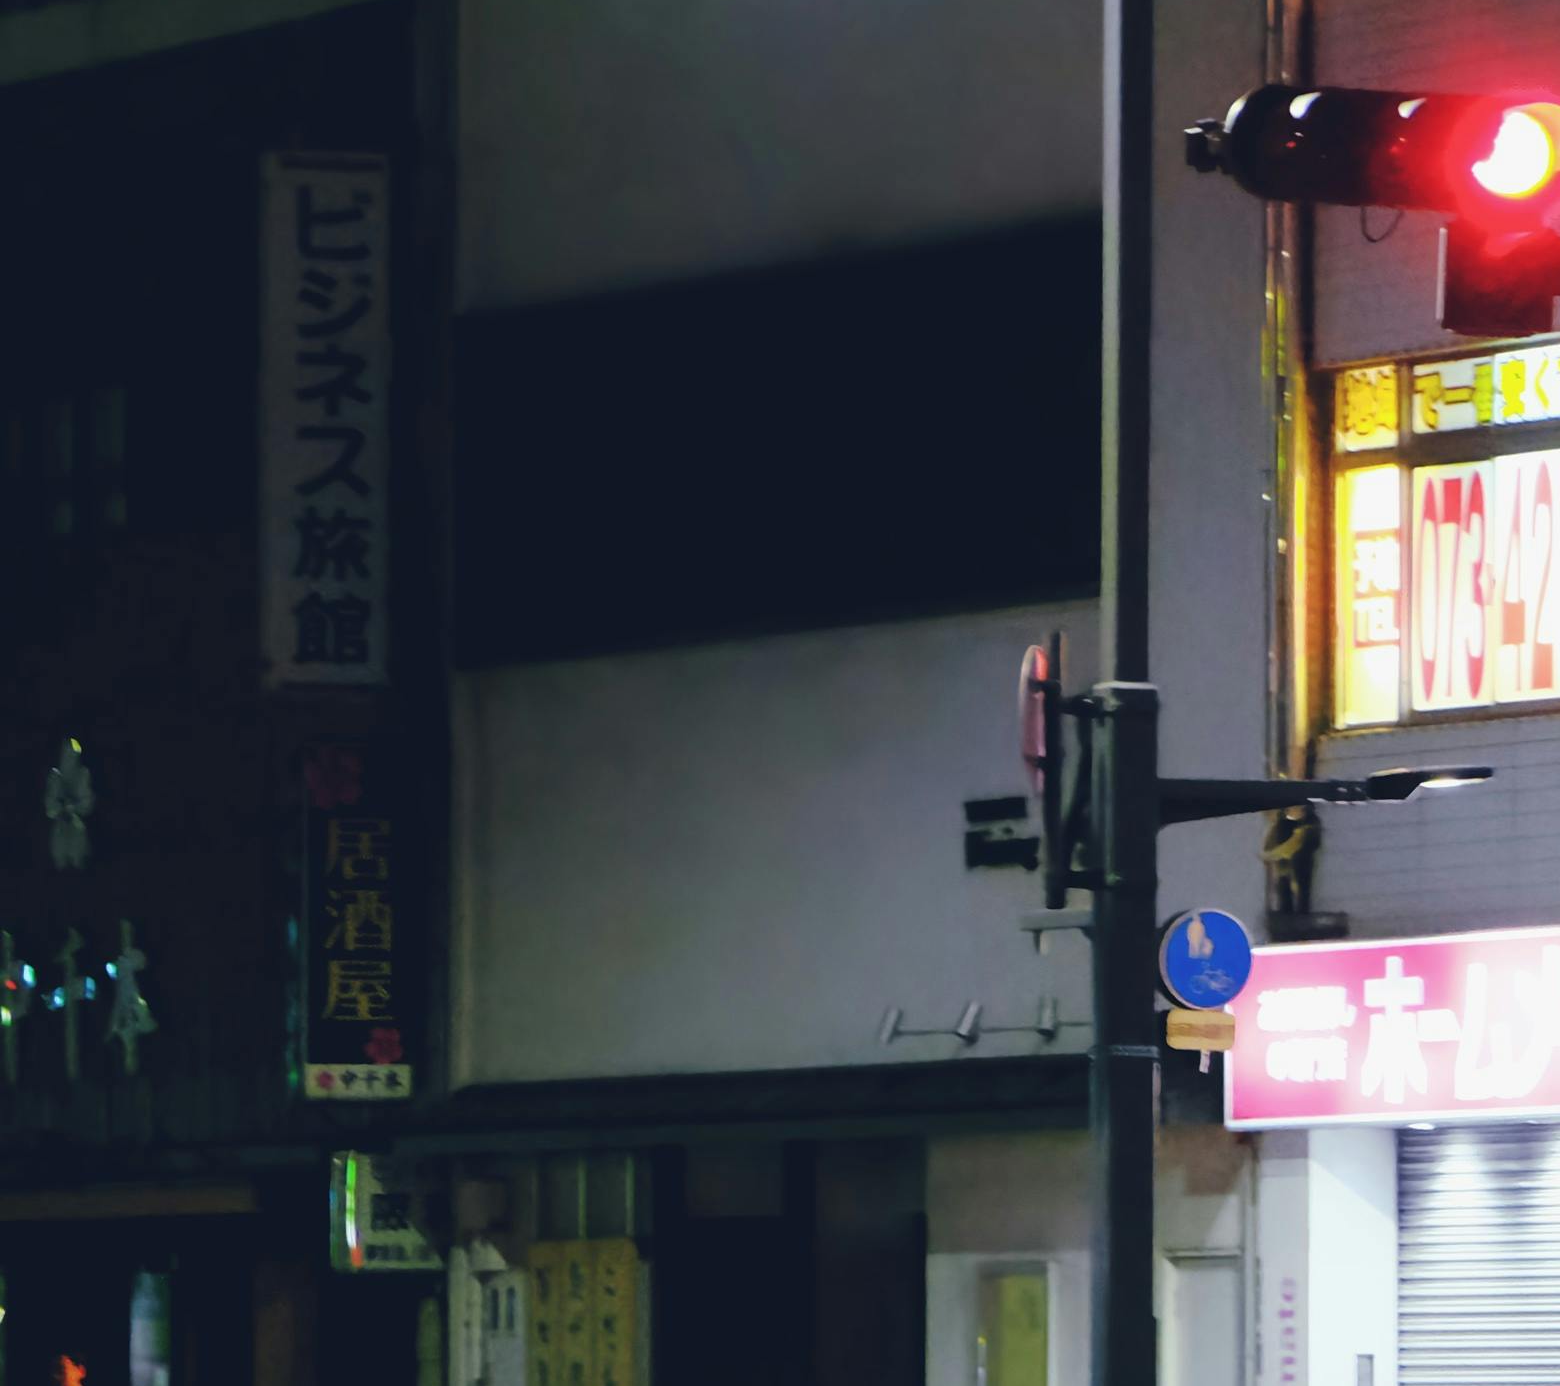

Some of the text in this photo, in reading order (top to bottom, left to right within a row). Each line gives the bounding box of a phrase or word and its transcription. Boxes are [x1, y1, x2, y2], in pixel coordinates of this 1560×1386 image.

[292, 181, 373, 666] ビジネス旅館
[321, 817, 395, 1022] 居酒屋
